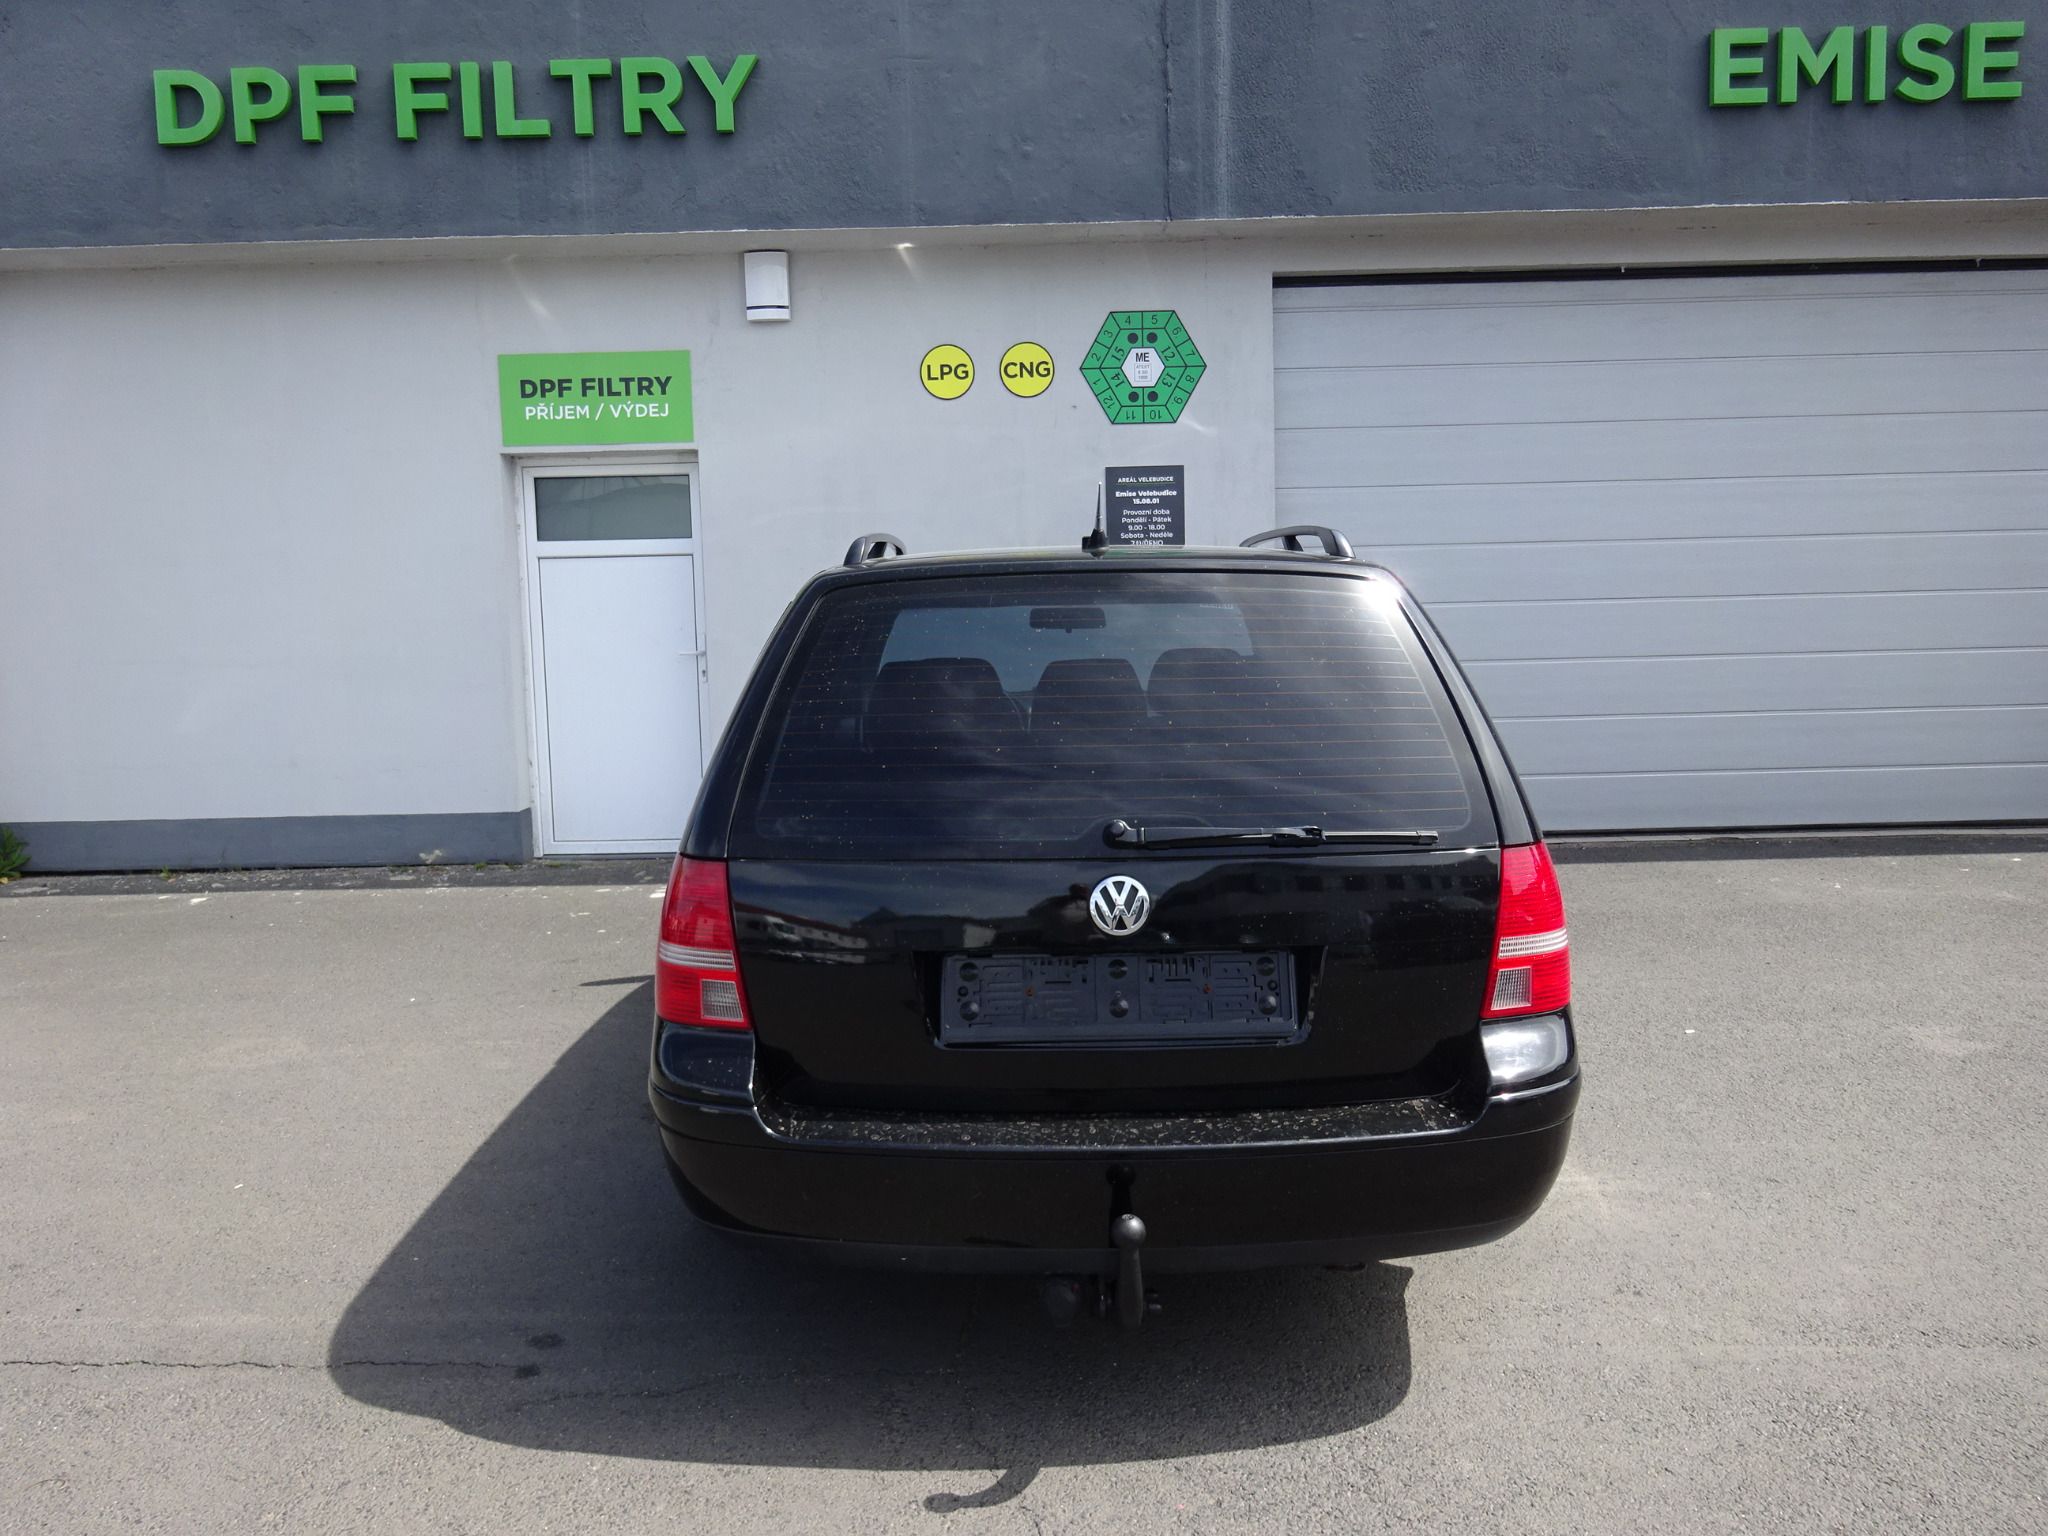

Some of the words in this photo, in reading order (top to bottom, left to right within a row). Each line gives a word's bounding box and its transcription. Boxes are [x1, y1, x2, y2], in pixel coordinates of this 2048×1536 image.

[1709, 21, 2024, 107] EMISE
[152, 65, 357, 147] DPF
[392, 54, 758, 141] FILTRY
[1125, 316, 1131, 326] 4
[1152, 315, 1158, 324] 5
[1103, 330, 1113, 338] 3
[1092, 353, 1101, 362] 2
[1111, 346, 1125, 362] 15
[1136, 353, 1150, 362] ME
[1161, 346, 1175, 361] 12
[927, 364, 969, 380] LPG
[1004, 361, 1050, 378] CNG
[1111, 373, 1125, 387] 14
[1162, 373, 1176, 388] 13
[1185, 375, 1194, 383] 8
[520, 378, 572, 398] DPF
[581, 376, 672, 397] FILTRY
[1103, 396, 1115, 409] 12
[525, 403, 589, 420] PŘÍJEM
[595, 403, 604, 421] /
[610, 401, 669, 418] VÝDEJ
[1150, 410, 1161, 419] 10
